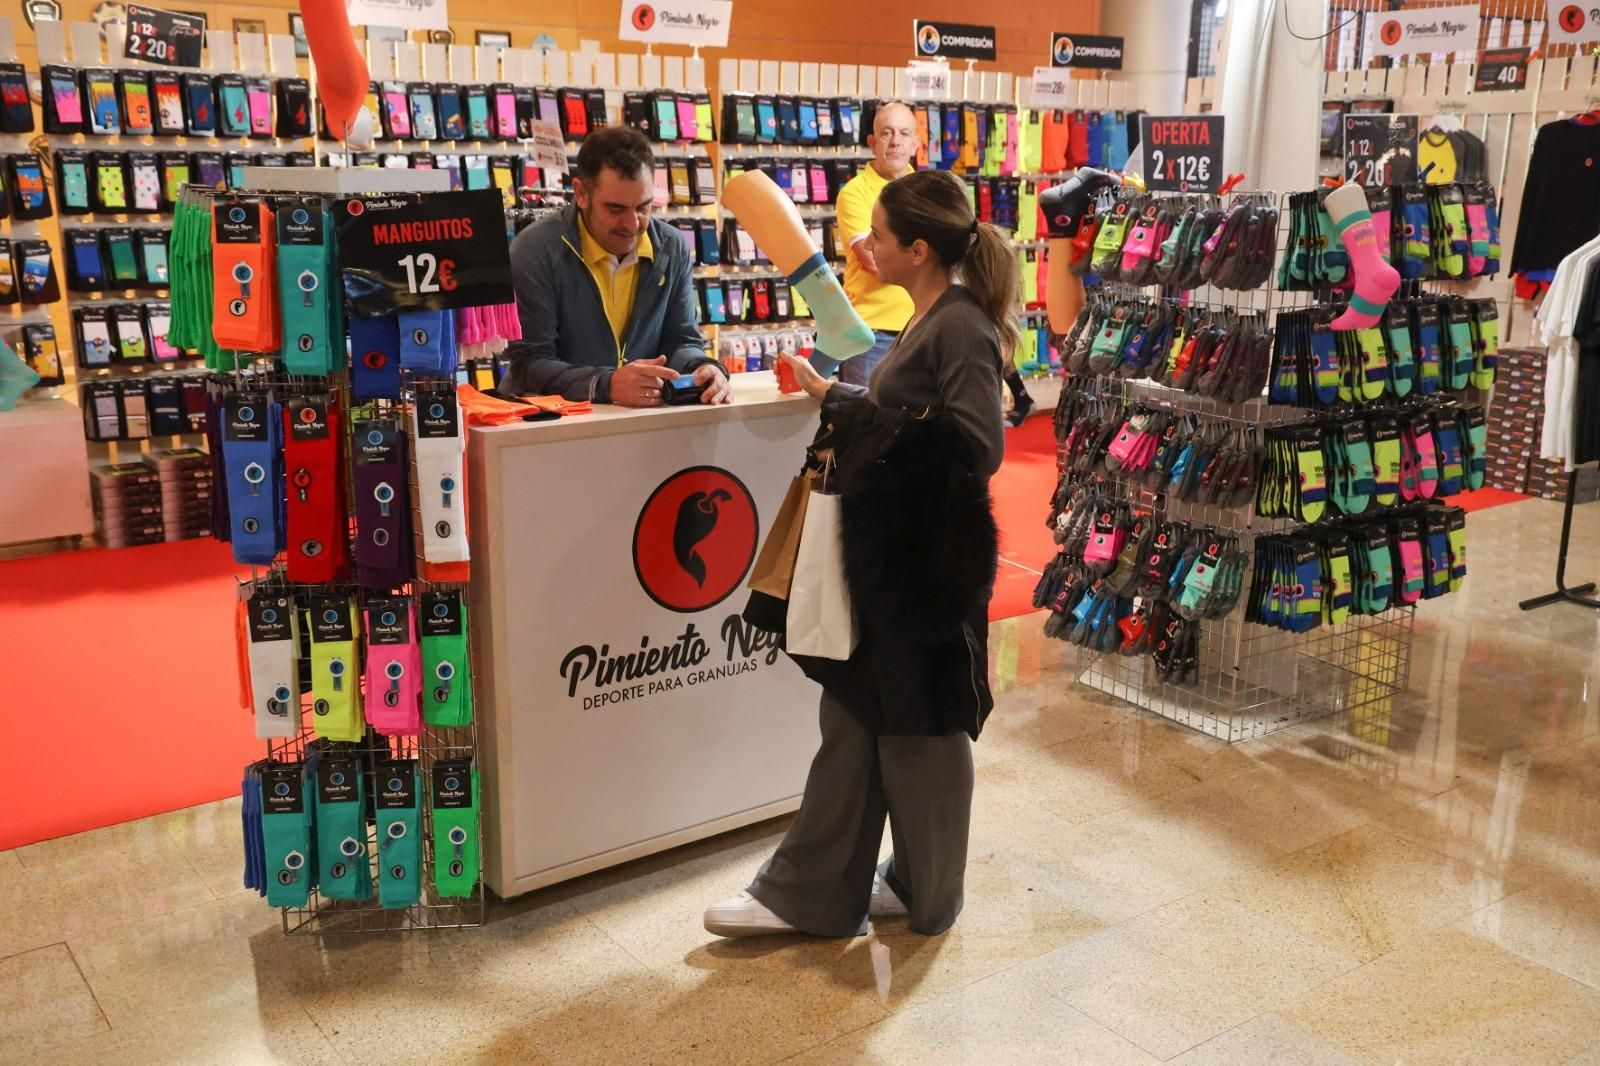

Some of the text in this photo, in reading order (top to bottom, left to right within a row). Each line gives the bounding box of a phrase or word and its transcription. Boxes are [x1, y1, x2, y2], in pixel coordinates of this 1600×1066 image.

[696, 13, 720, 30] Negro
[1406, 21, 1439, 35] Pimiento
[1442, 20, 1467, 37] Negro
[941, 35, 994, 49] COMPRESIÓN
[1074, 46, 1121, 58] COMPRESIÓN
[1152, 120, 1210, 145] OFERTA
[373, 217, 473, 246] MANGUITOS
[397, 252, 458, 295] 12€
[559, 614, 783, 698] Pimiento Neg
[583, 659, 758, 710] DEPORTE PARA GRANUJAS
